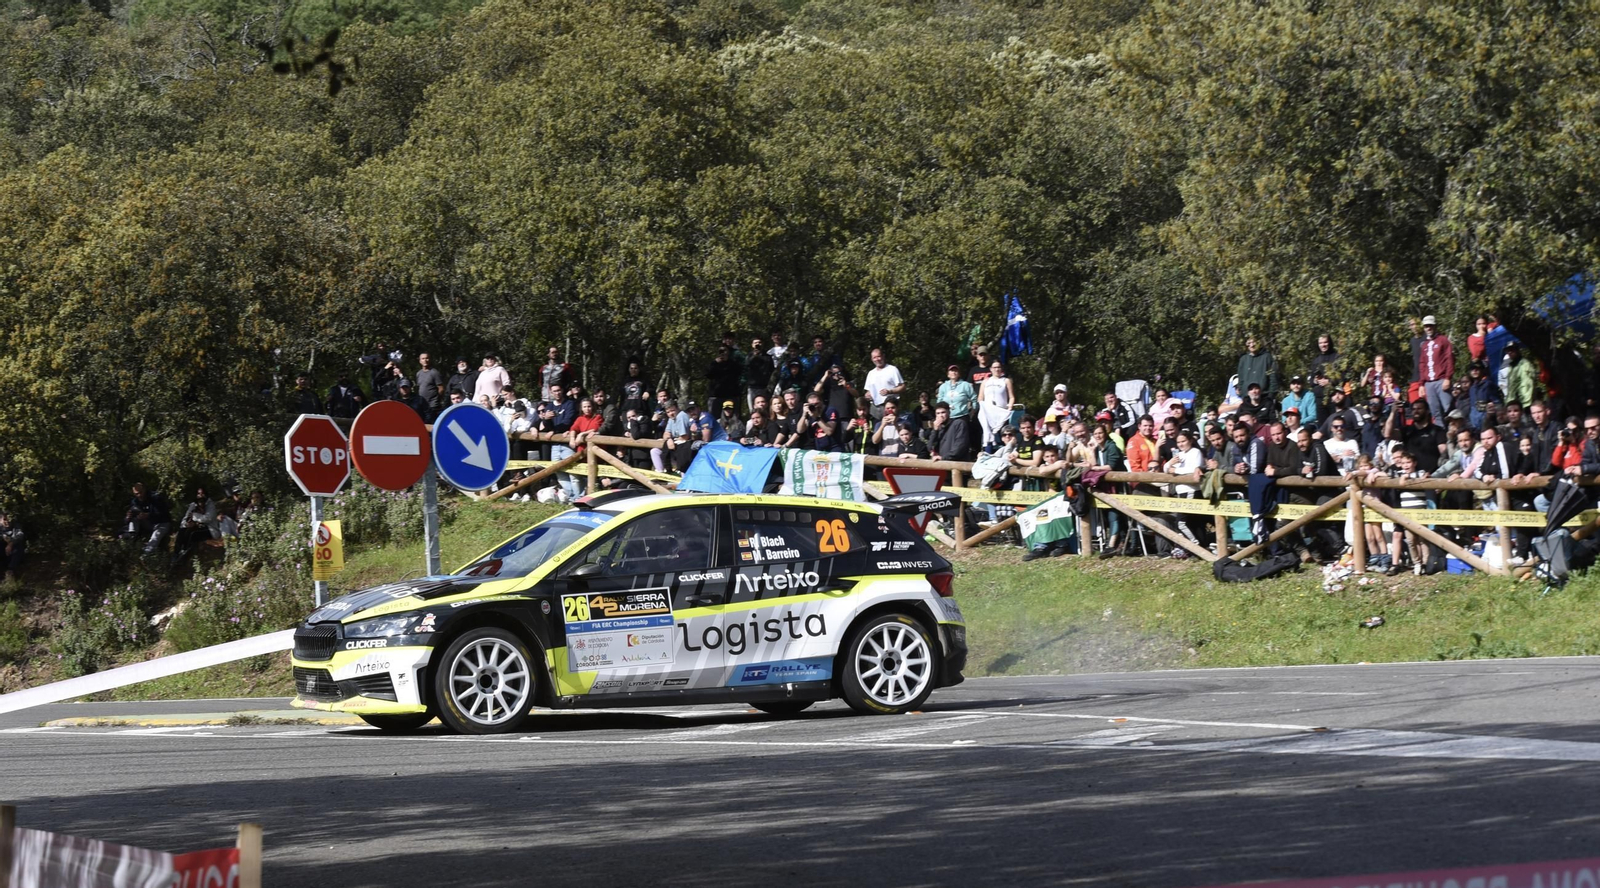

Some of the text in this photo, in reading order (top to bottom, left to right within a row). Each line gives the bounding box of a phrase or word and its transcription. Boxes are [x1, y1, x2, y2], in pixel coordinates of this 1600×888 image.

[293, 446, 346, 466] STOP
[760, 535, 786, 548] Blach
[815, 519, 851, 553] 26
[316, 547, 332, 560] 60
[766, 548, 801, 560] Barreiro
[902, 561, 933, 569] INVEST
[679, 572, 725, 583] CLICKFER
[734, 568, 820, 595] Arteixo
[626, 593, 666, 603] SIERRA
[564, 595, 590, 623] 26
[590, 596, 669, 617] 42
[620, 601, 668, 612] MORENA
[613, 618, 649, 628] Championship
[346, 640, 388, 650] CLICKFER
[355, 660, 391, 674] Arteixo
[771, 664, 821, 673] RALLYE
